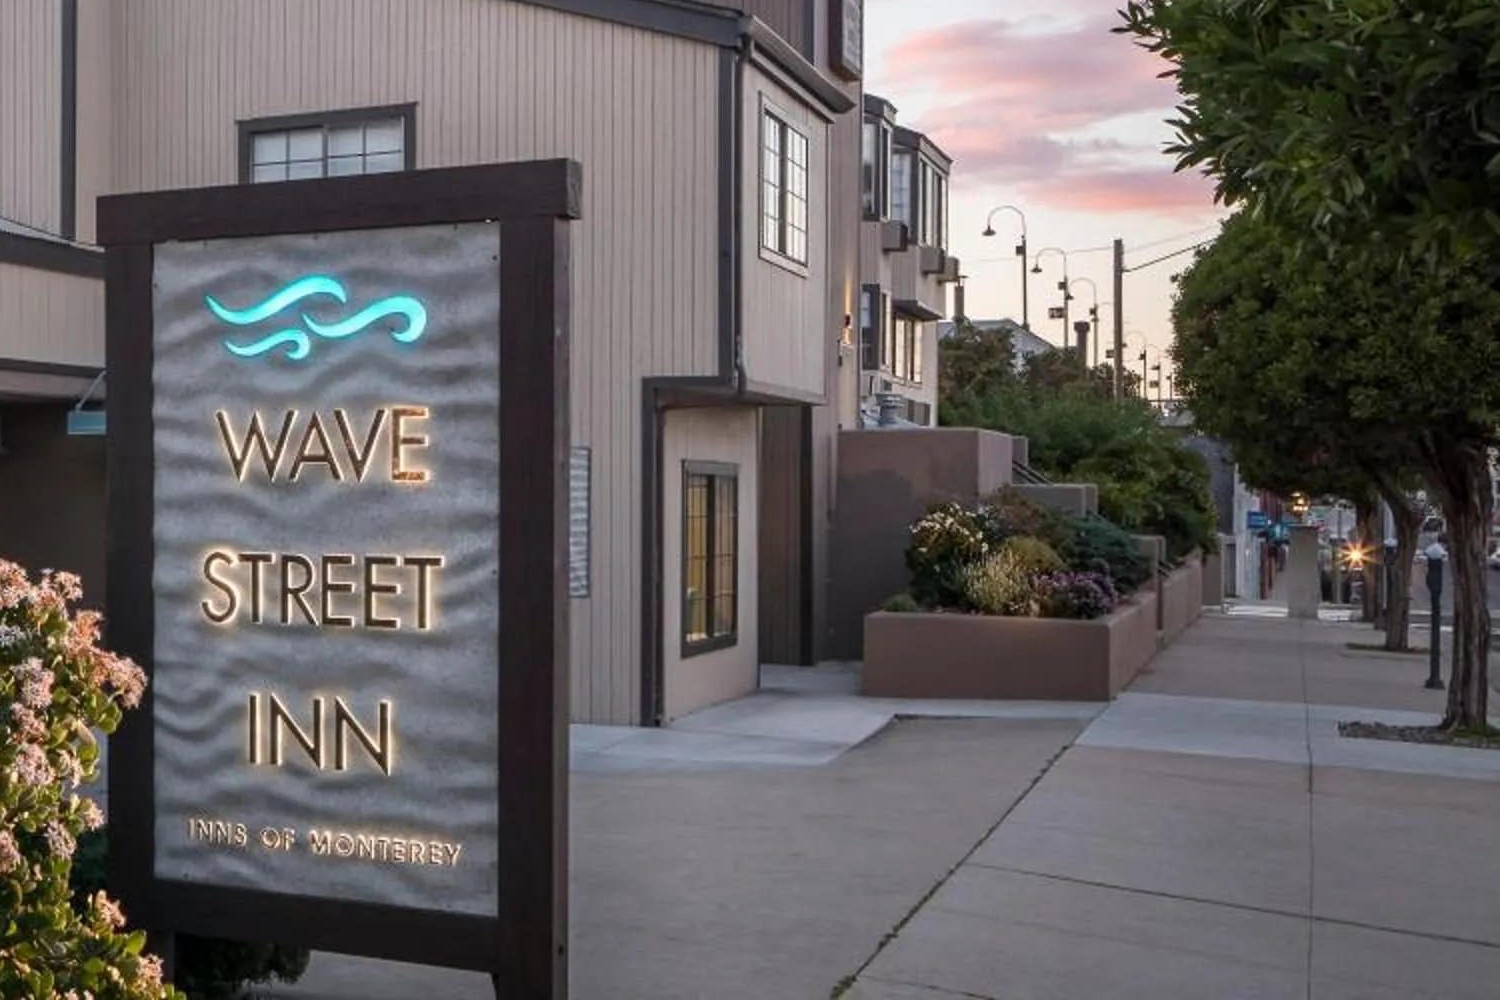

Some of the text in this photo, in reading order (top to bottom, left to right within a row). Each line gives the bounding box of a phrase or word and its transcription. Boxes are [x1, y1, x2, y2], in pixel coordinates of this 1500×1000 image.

[214, 405, 430, 484] WAVE
[199, 549, 445, 632] STREET
[246, 692, 394, 777] INN
[188, 818, 462, 868] INNS OF MONTEREY
